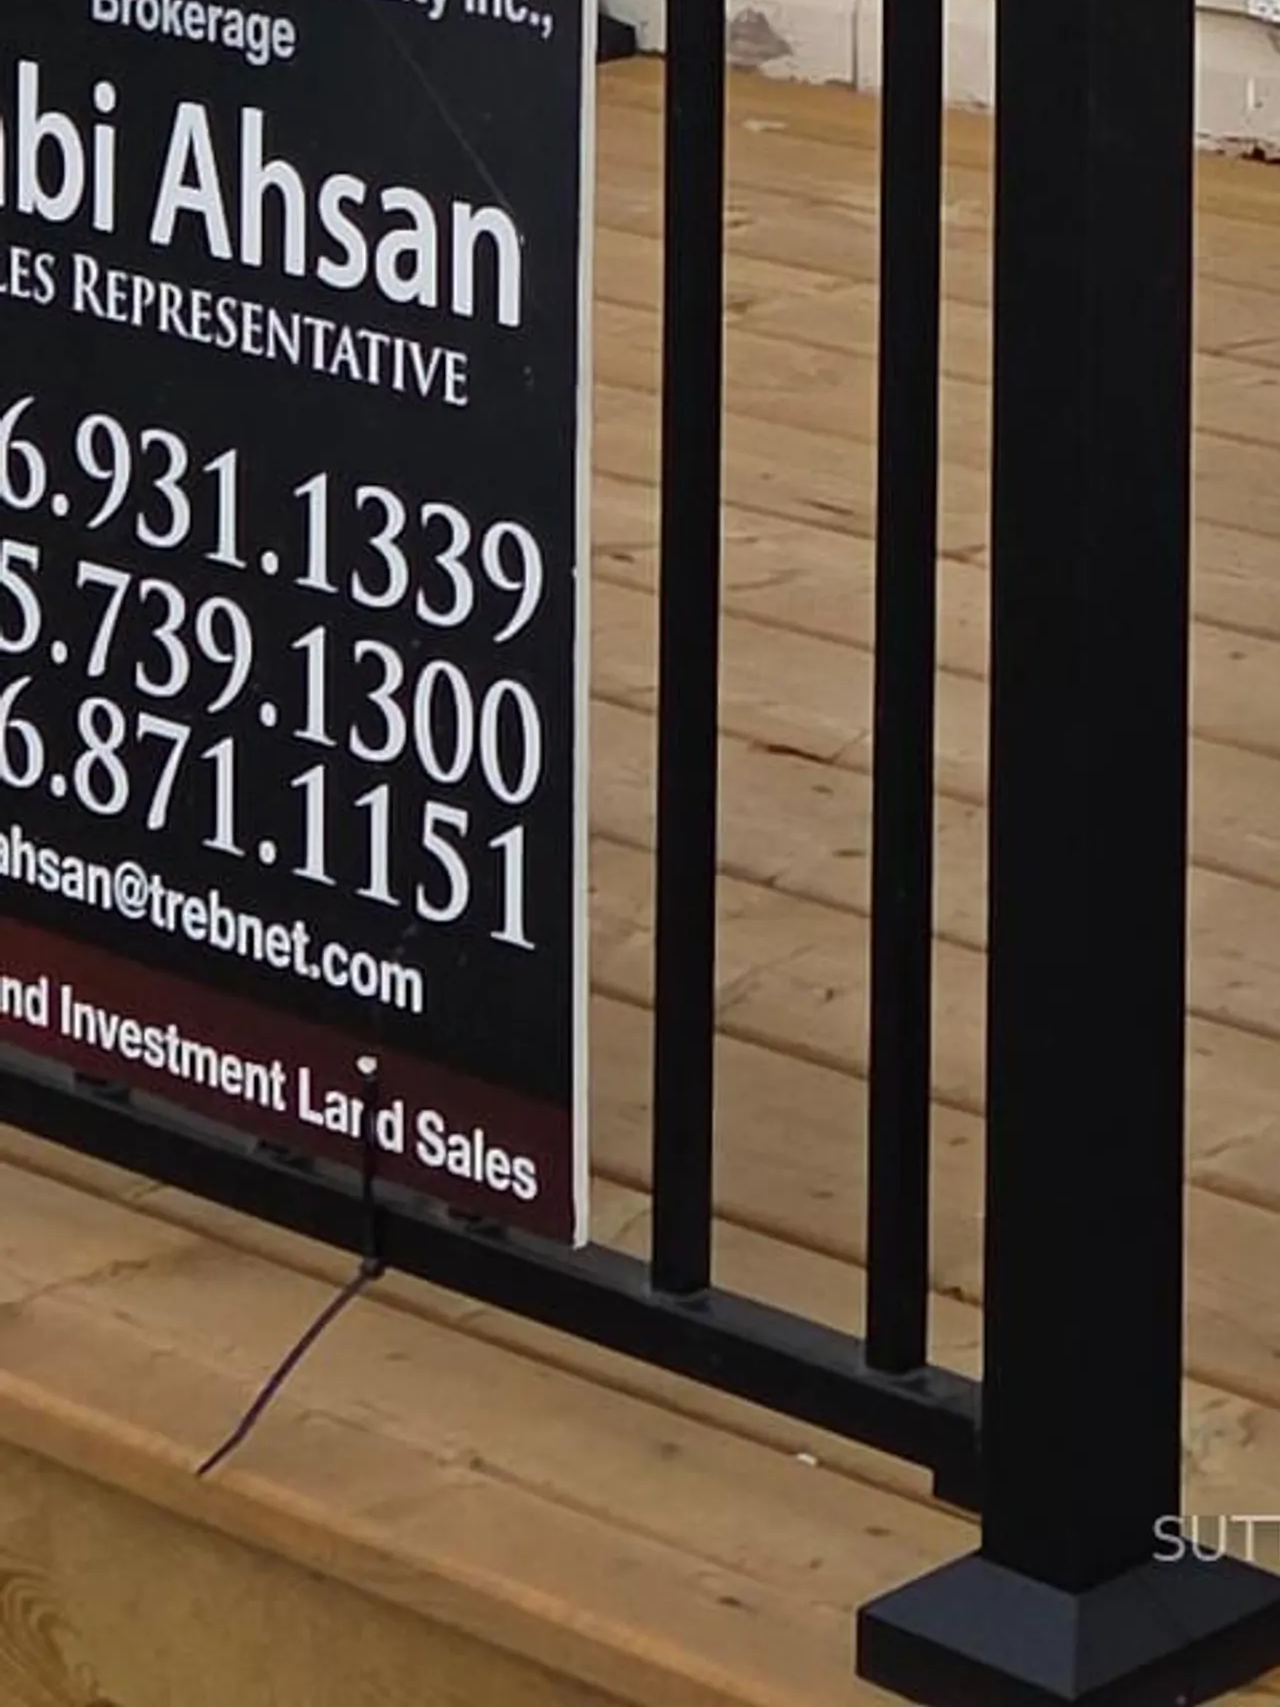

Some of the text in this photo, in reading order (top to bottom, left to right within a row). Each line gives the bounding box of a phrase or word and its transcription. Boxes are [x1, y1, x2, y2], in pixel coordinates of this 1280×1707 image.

[0, 60, 523, 329] bi Ahsan
[72, 252, 469, 407] REPRESENTATIVE
[0, 396, 544, 643] 6.931.1339
[0, 539, 543, 806] 5.739.1300
[0, 676, 536, 951] 6.871.1151
[61, 984, 288, 1113] Investment
[416, 1109, 539, 1201] Sales
